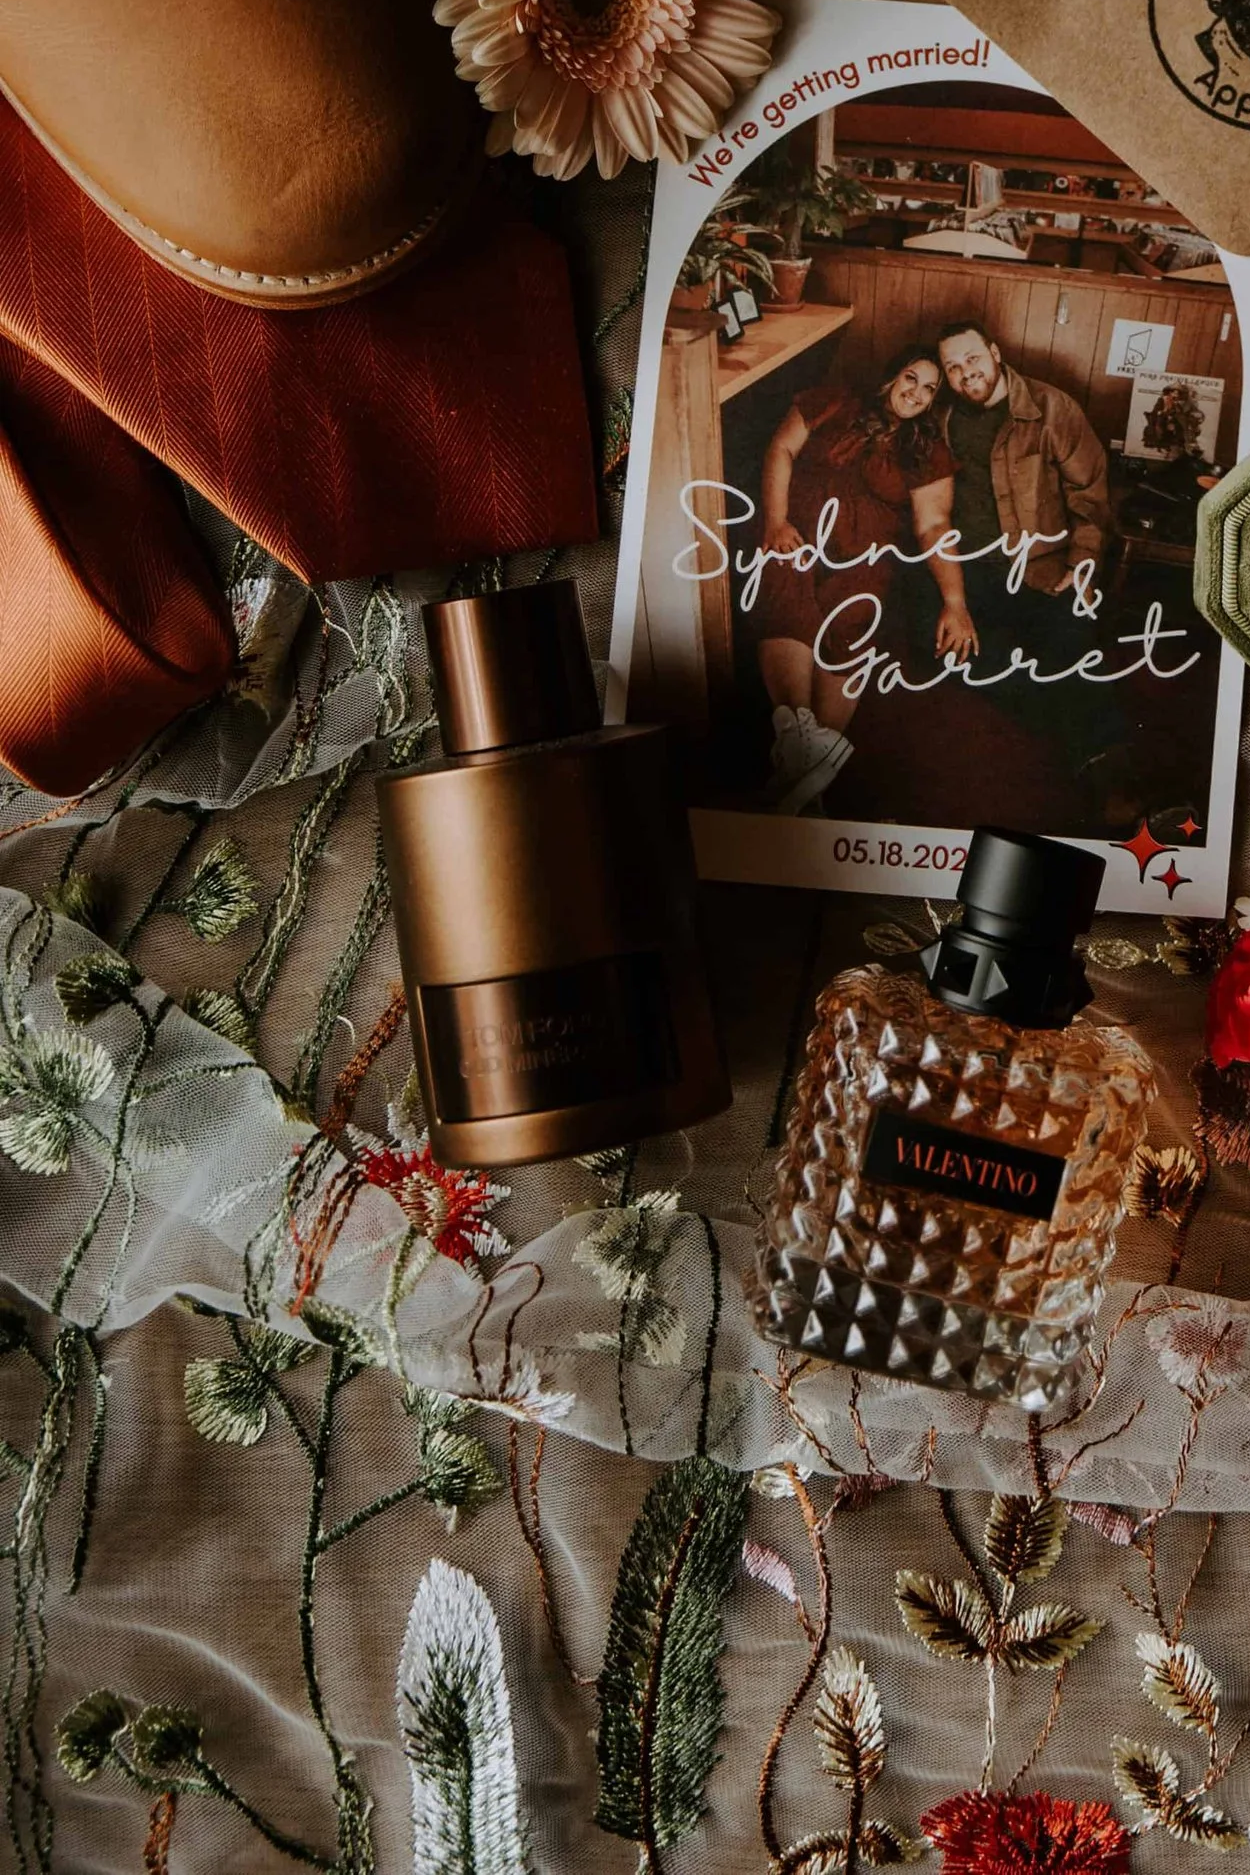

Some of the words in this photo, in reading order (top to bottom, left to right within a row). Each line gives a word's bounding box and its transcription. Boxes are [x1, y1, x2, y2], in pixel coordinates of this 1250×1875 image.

[687, 121, 760, 188] We're
[762, 61, 861, 129] getting
[866, 38, 992, 75] married!
[671, 479, 1068, 613] Sydney
[1070, 557, 1104, 620] &
[812, 591, 1201, 701] Garret
[832, 836, 969, 872] 05.18.202
[896, 1136, 1038, 1198] VALENTINO
